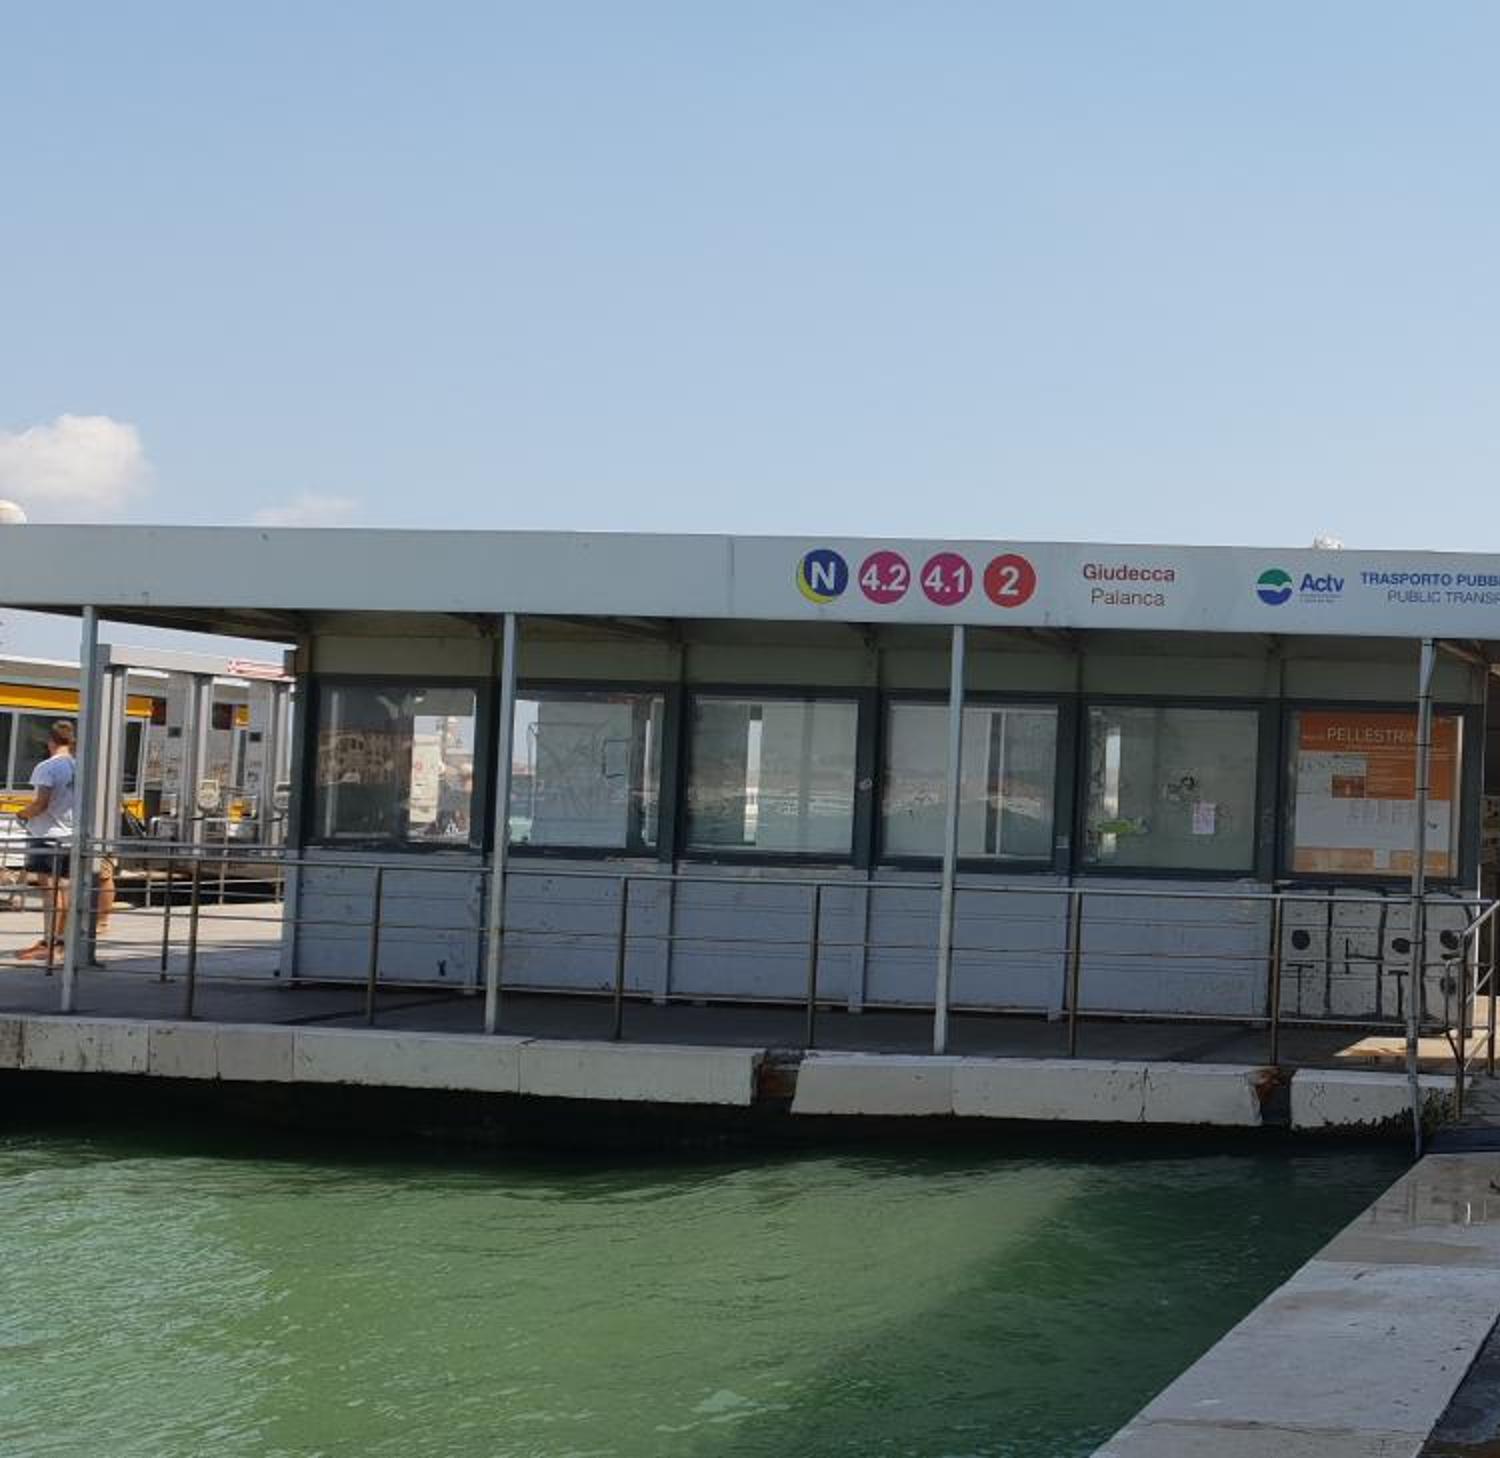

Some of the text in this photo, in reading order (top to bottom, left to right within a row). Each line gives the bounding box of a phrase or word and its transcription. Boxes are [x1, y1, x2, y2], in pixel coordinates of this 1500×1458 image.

[810, 561, 1021, 596] N 4.2 4.1 2
[1083, 563, 1175, 582] Giudecca
[1360, 571, 1452, 586] TRASPORTO
[1299, 573, 1345, 592] Actv
[1091, 587, 1165, 606] Palanca
[1387, 590, 1440, 603] PUBLIC
